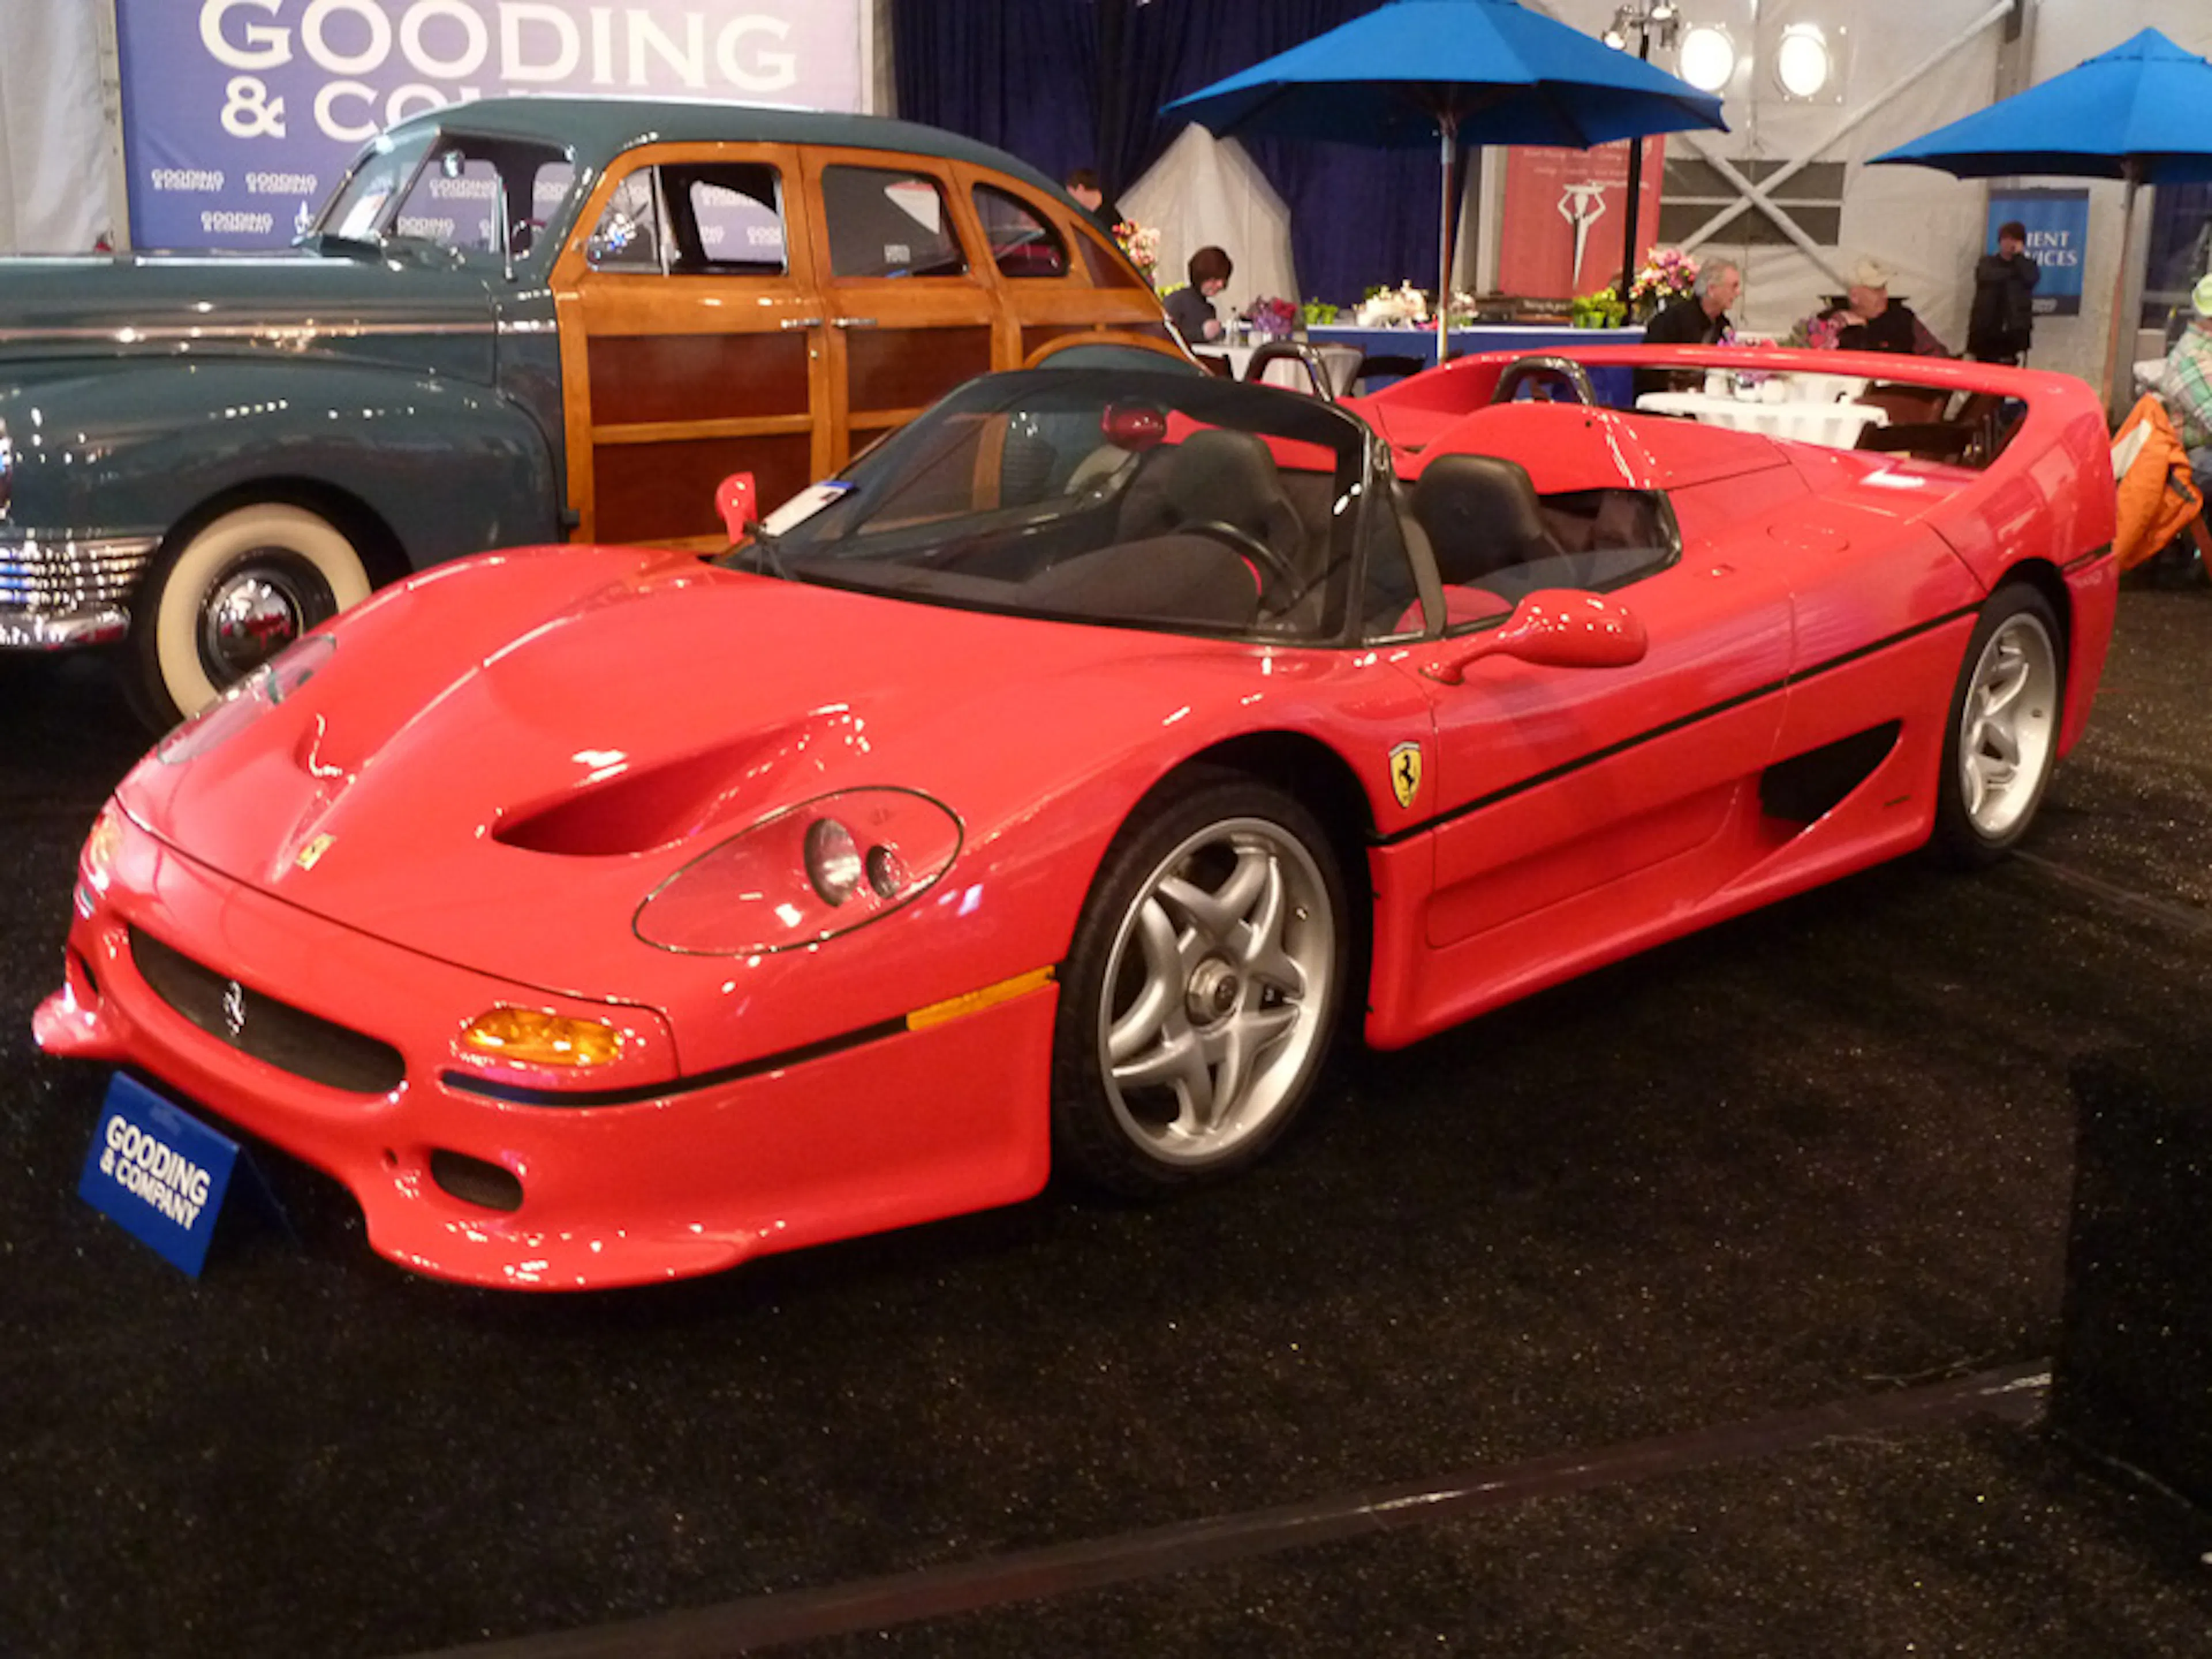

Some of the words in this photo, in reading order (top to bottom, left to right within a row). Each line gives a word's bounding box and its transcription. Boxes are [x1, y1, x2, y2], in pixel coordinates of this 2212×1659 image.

[199, 0, 797, 92] GOODING
[221, 75, 286, 138] &
[2027, 232, 2069, 247] IENT
[107, 1115, 210, 1206] GOODING
[116, 1158, 200, 1230] COMPANY
